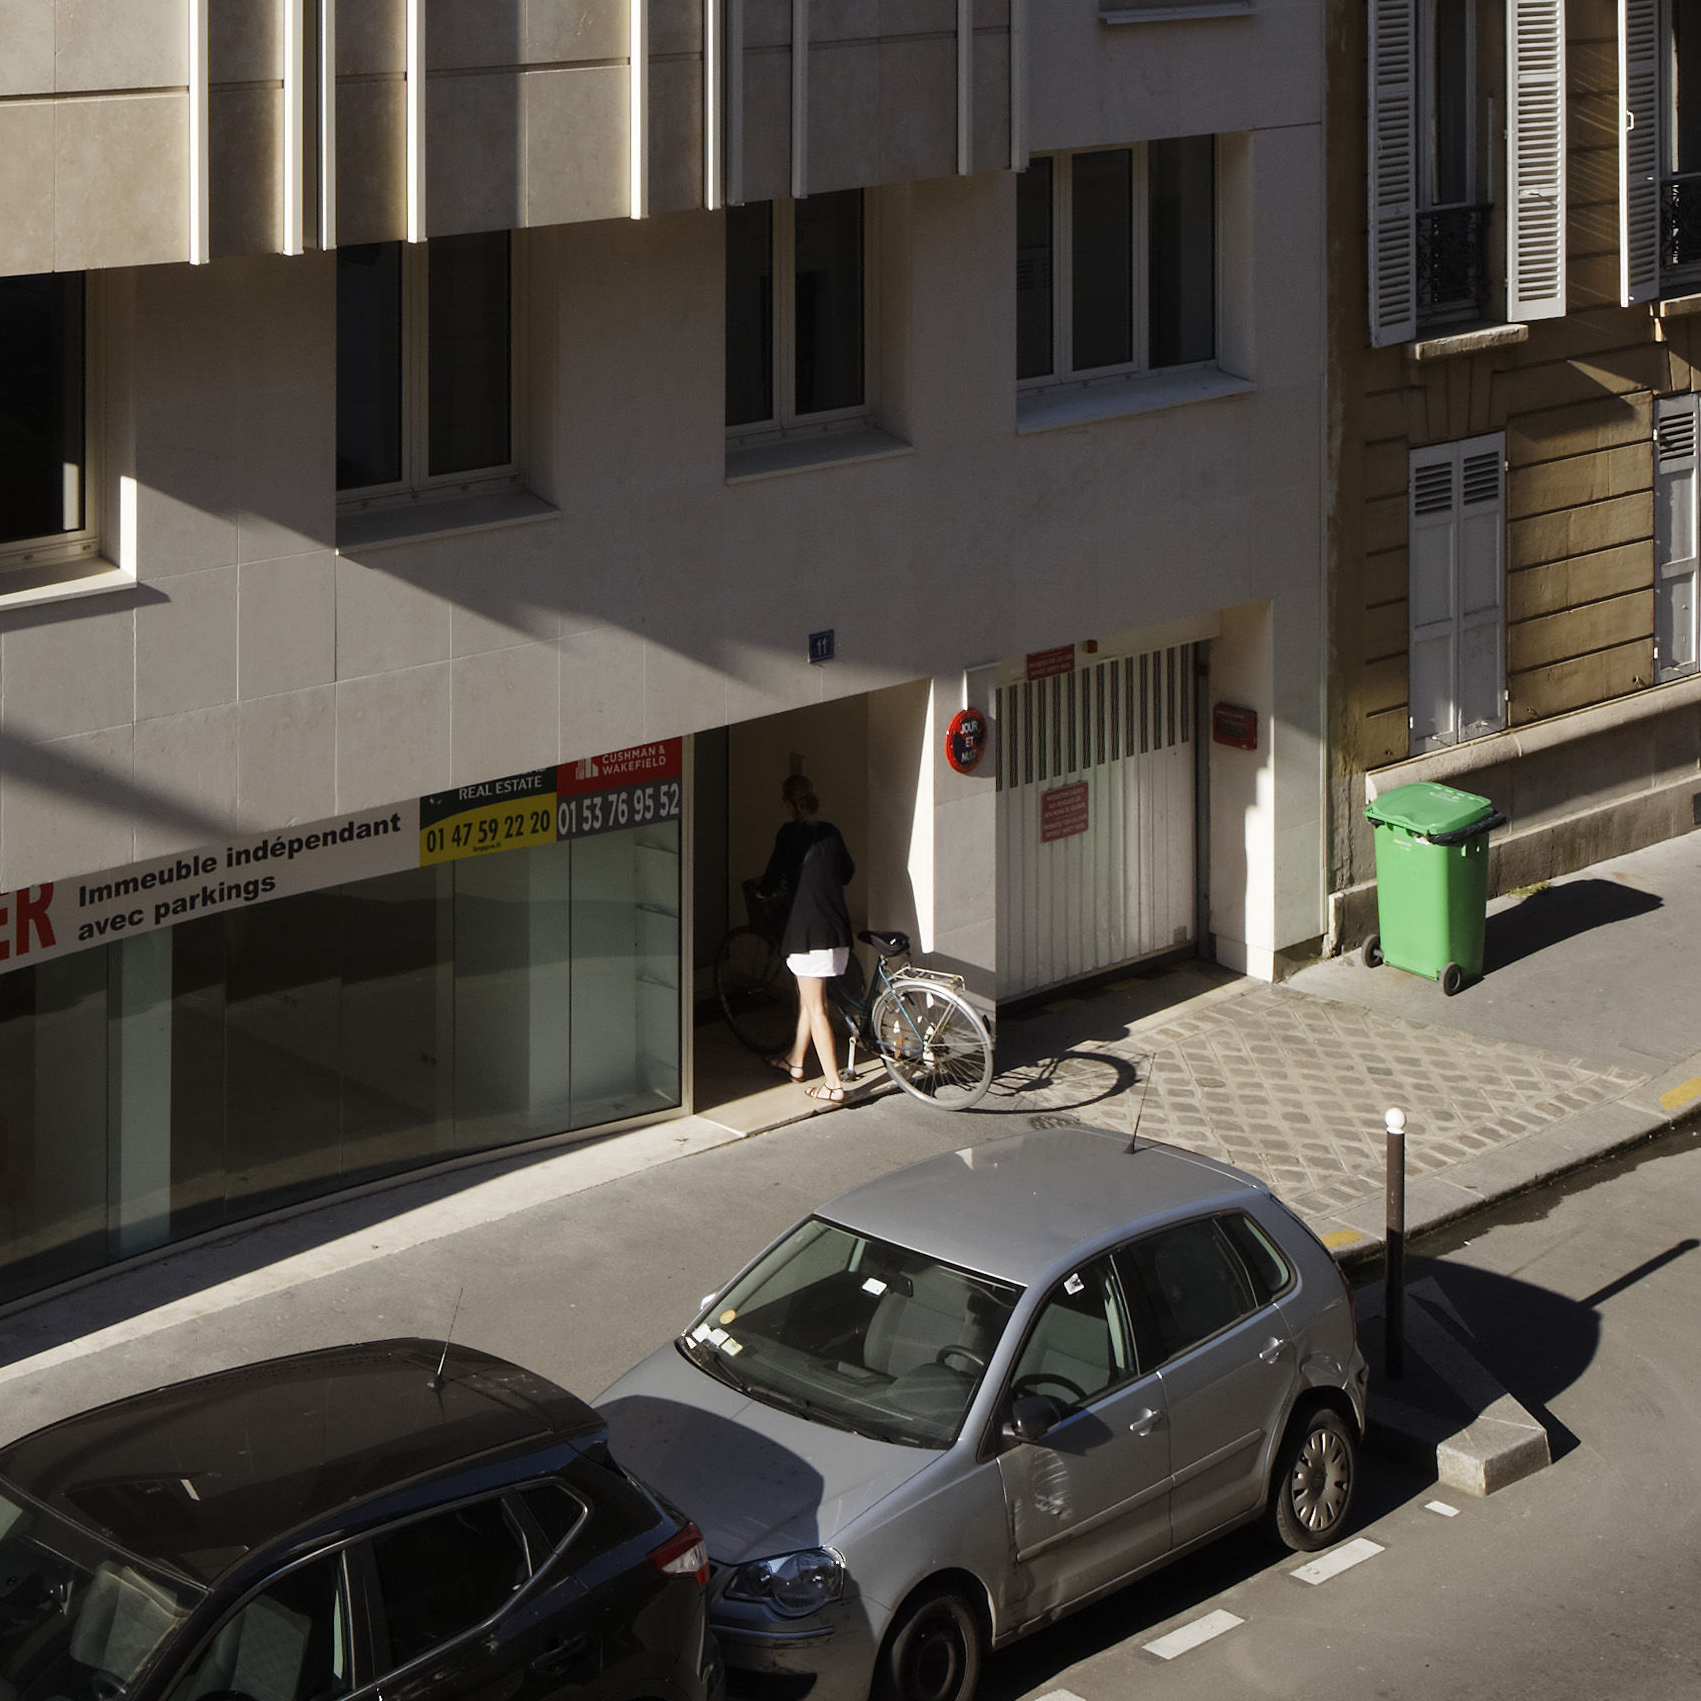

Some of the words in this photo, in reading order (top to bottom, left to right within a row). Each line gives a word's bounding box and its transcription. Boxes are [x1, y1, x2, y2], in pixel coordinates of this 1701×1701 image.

[816, 637, 827, 655] 11
[960, 720, 978, 734] JOUR
[964, 736, 973, 748] ET
[602, 747, 656, 764] CUSHMAN
[658, 745, 665, 755] &
[602, 755, 666, 776] WAKEFIELD
[459, 783, 492, 800] REAL
[496, 775, 542, 795] ESTATE
[558, 802, 577, 836] 01
[582, 796, 602, 831] 53
[608, 791, 628, 826] 76
[633, 787, 654, 822] 95
[660, 782, 679, 817] 52
[426, 827, 444, 853] 01
[452, 822, 473, 847] 47
[478, 818, 498, 843] 59
[505, 813, 524, 839] 22
[530, 809, 550, 834] 20
[79, 856, 217, 907] Immeuble
[226, 813, 401, 868] indépendant
[77, 907, 144, 941] avec
[154, 873, 276, 925] parkings
